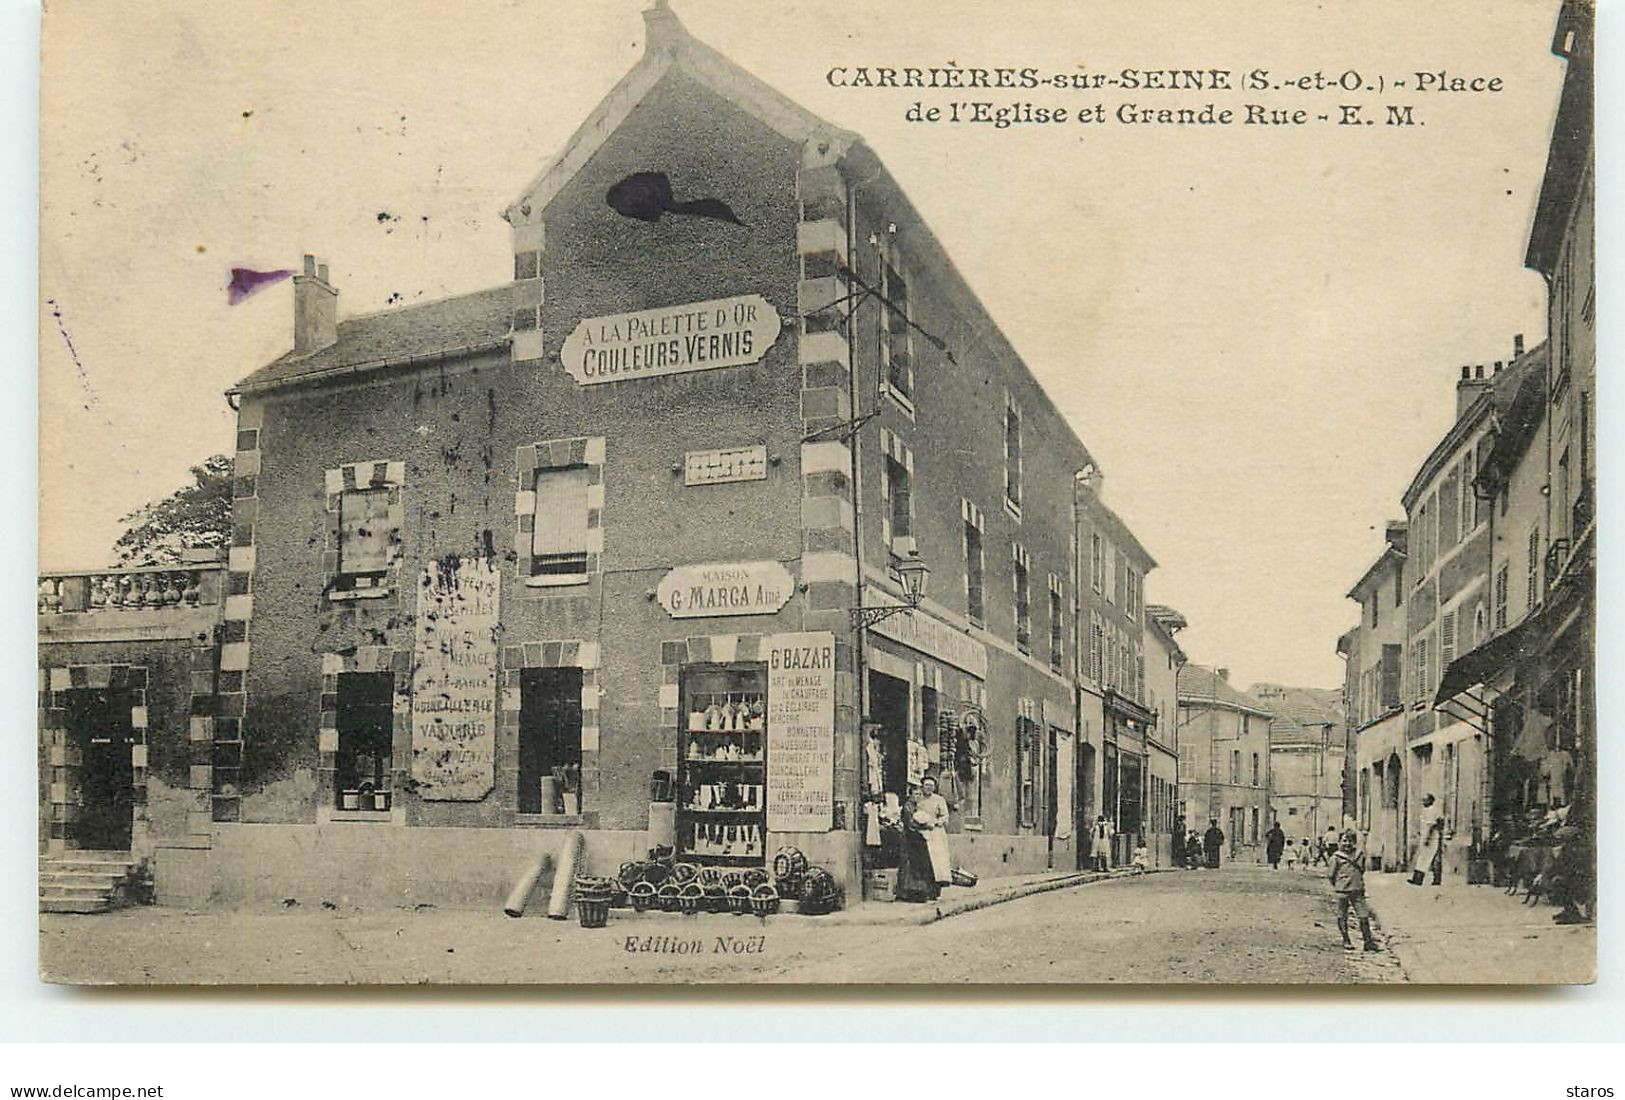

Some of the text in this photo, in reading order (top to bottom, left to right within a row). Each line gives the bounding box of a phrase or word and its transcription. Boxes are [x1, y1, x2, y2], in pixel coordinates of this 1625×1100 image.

[582, 303, 757, 346] A LA PALETTE D'OR
[702, 569, 749, 582] MAISON
